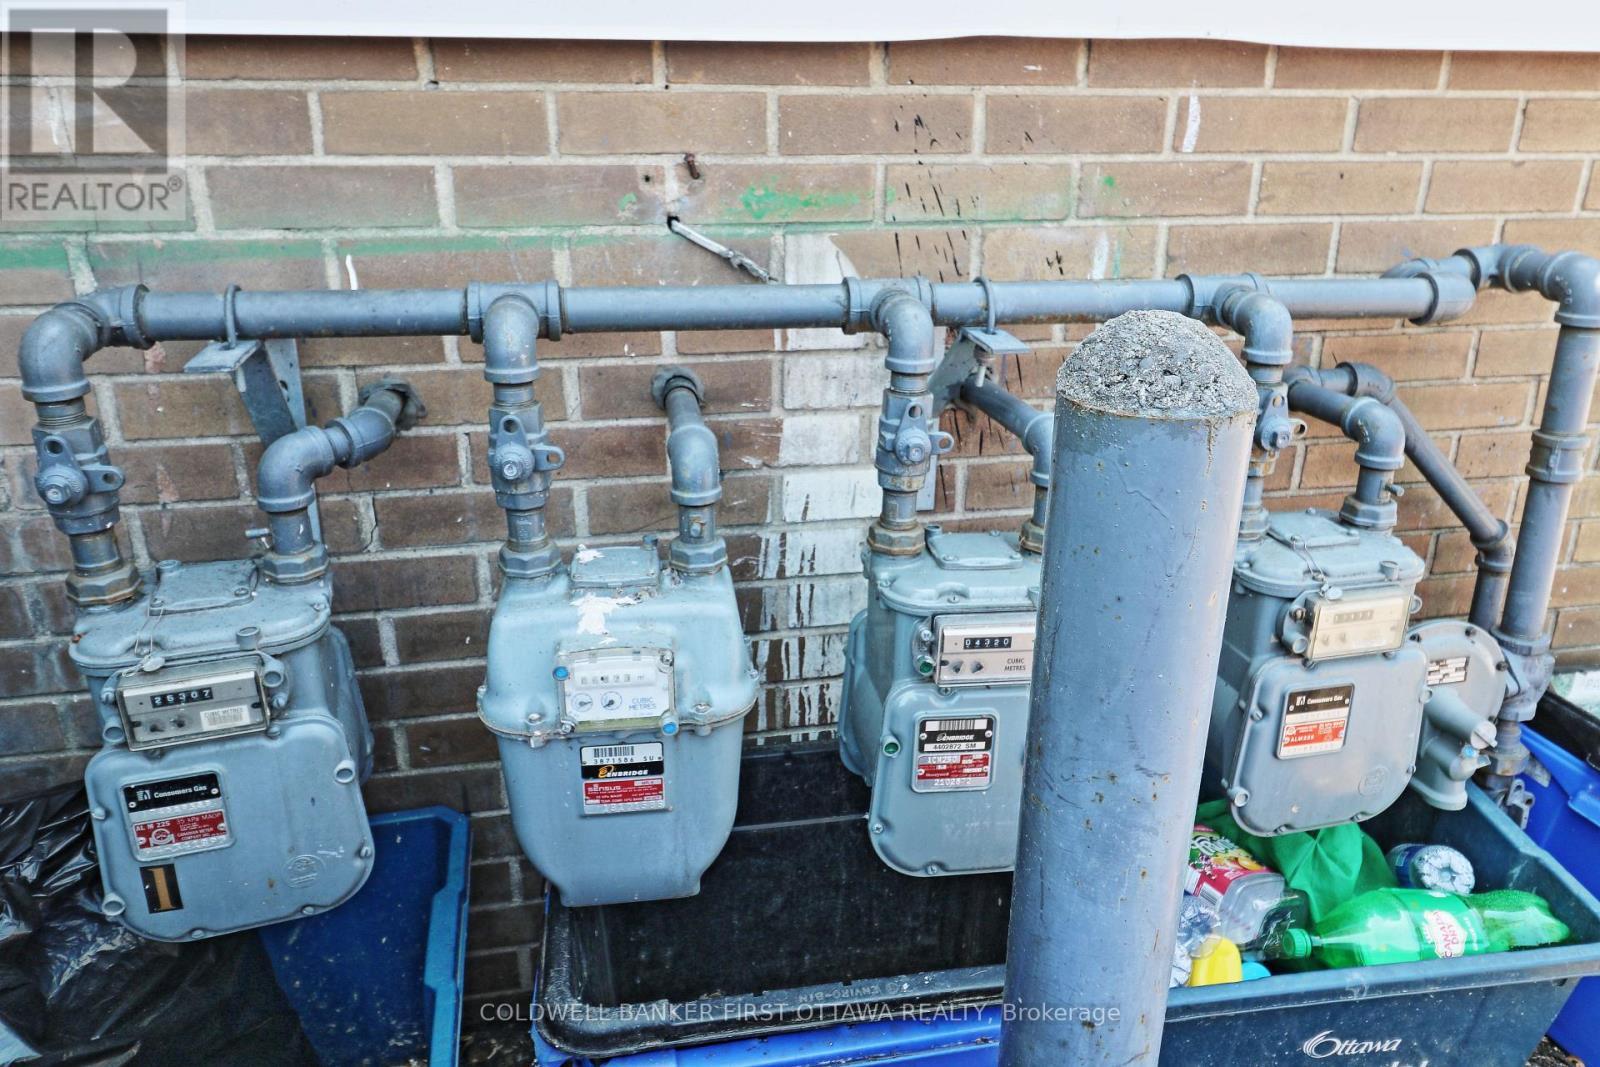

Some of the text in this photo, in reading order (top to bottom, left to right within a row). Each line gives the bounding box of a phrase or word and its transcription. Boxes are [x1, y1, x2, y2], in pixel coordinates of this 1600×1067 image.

[965, 638, 1009, 647] 04320
[154, 788, 192, 799] Consumers
[1303, 1029, 1402, 1058] Ottawa
